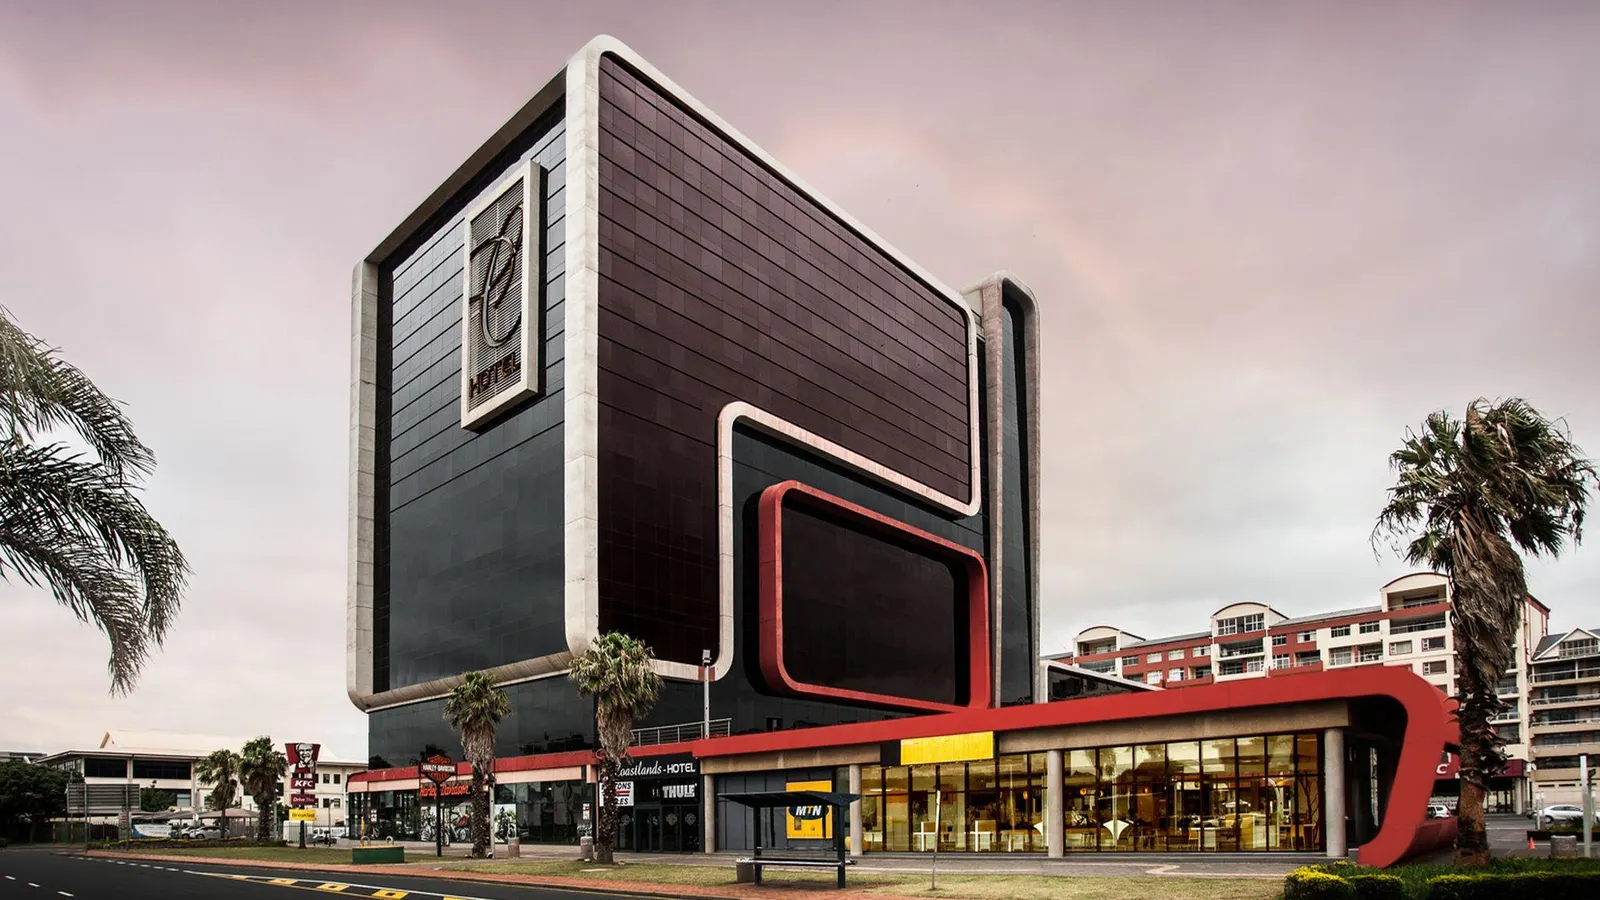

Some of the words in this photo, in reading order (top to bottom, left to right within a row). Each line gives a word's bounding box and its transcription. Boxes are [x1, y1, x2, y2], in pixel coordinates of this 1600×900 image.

[469, 351, 521, 399] HOTEL
[618, 760, 662, 777] oastlands
[666, 762, 696, 774] HOTEL
[295, 780, 313, 788] KFC
[662, 784, 695, 799] THULE
[795, 805, 822, 816] MTN
